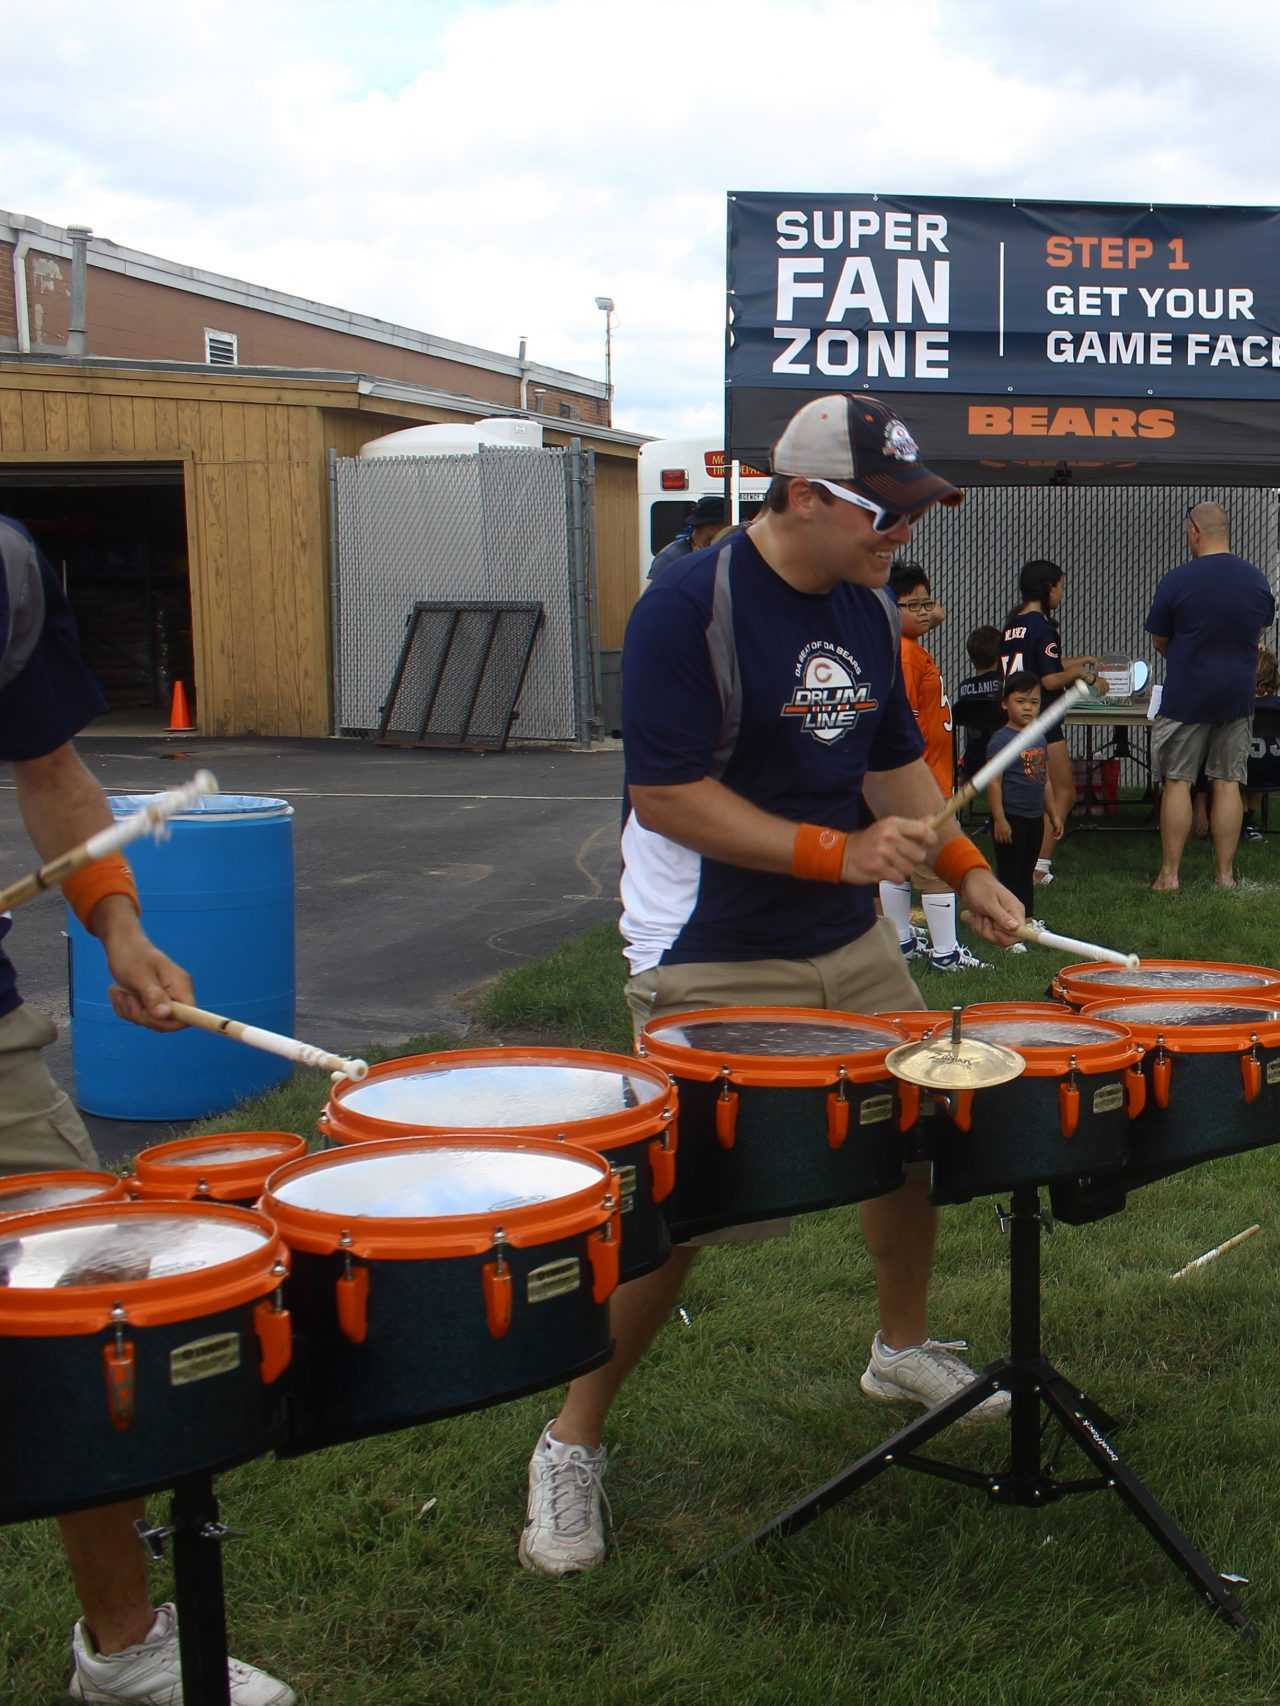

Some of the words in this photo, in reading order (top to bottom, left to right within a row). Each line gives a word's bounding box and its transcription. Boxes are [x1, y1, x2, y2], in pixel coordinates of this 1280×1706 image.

[776, 210, 949, 253] SUPER
[1046, 236, 1153, 269] STEP
[1168, 238, 1190, 270] 1
[776, 257, 950, 324] FAN
[1046, 286, 1128, 317] GET
[1138, 287, 1255, 320] YOUR
[772, 328, 949, 379] ZONE
[1046, 331, 1172, 365] GAME
[968, 406, 1175, 439] BEARS
[811, 640, 822, 649] OF
[824, 641, 834, 651] DA
[836, 646, 862, 675] BEARS
[795, 688, 867, 705] DRUM
[805, 711, 856, 728] LINE
